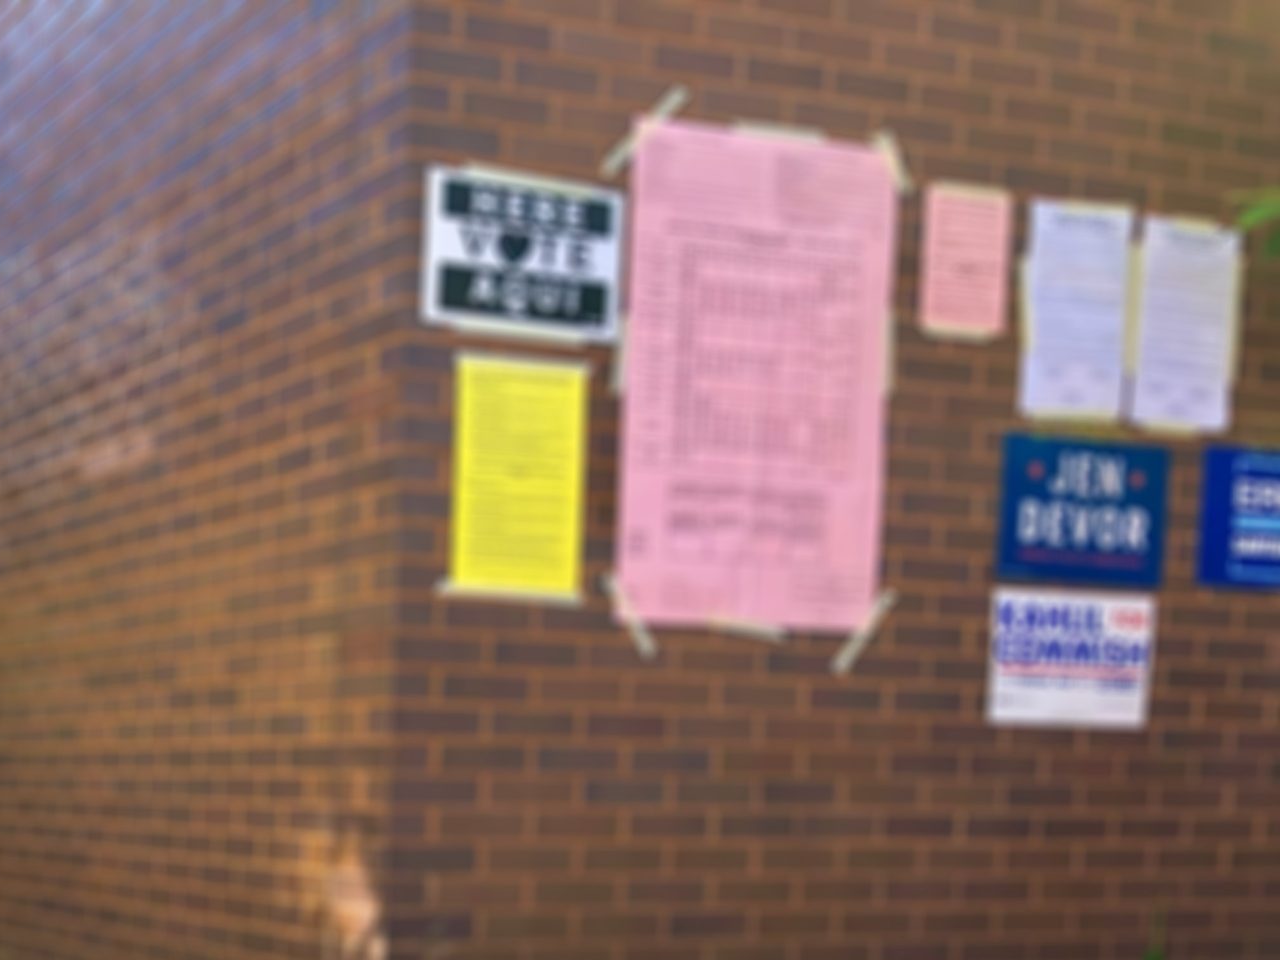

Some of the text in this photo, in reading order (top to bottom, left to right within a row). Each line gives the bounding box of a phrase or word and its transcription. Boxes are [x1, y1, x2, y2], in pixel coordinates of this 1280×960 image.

[459, 220, 593, 271] VTE
[1048, 451, 1126, 499] JEN
[1017, 498, 1149, 552] DEVOR
